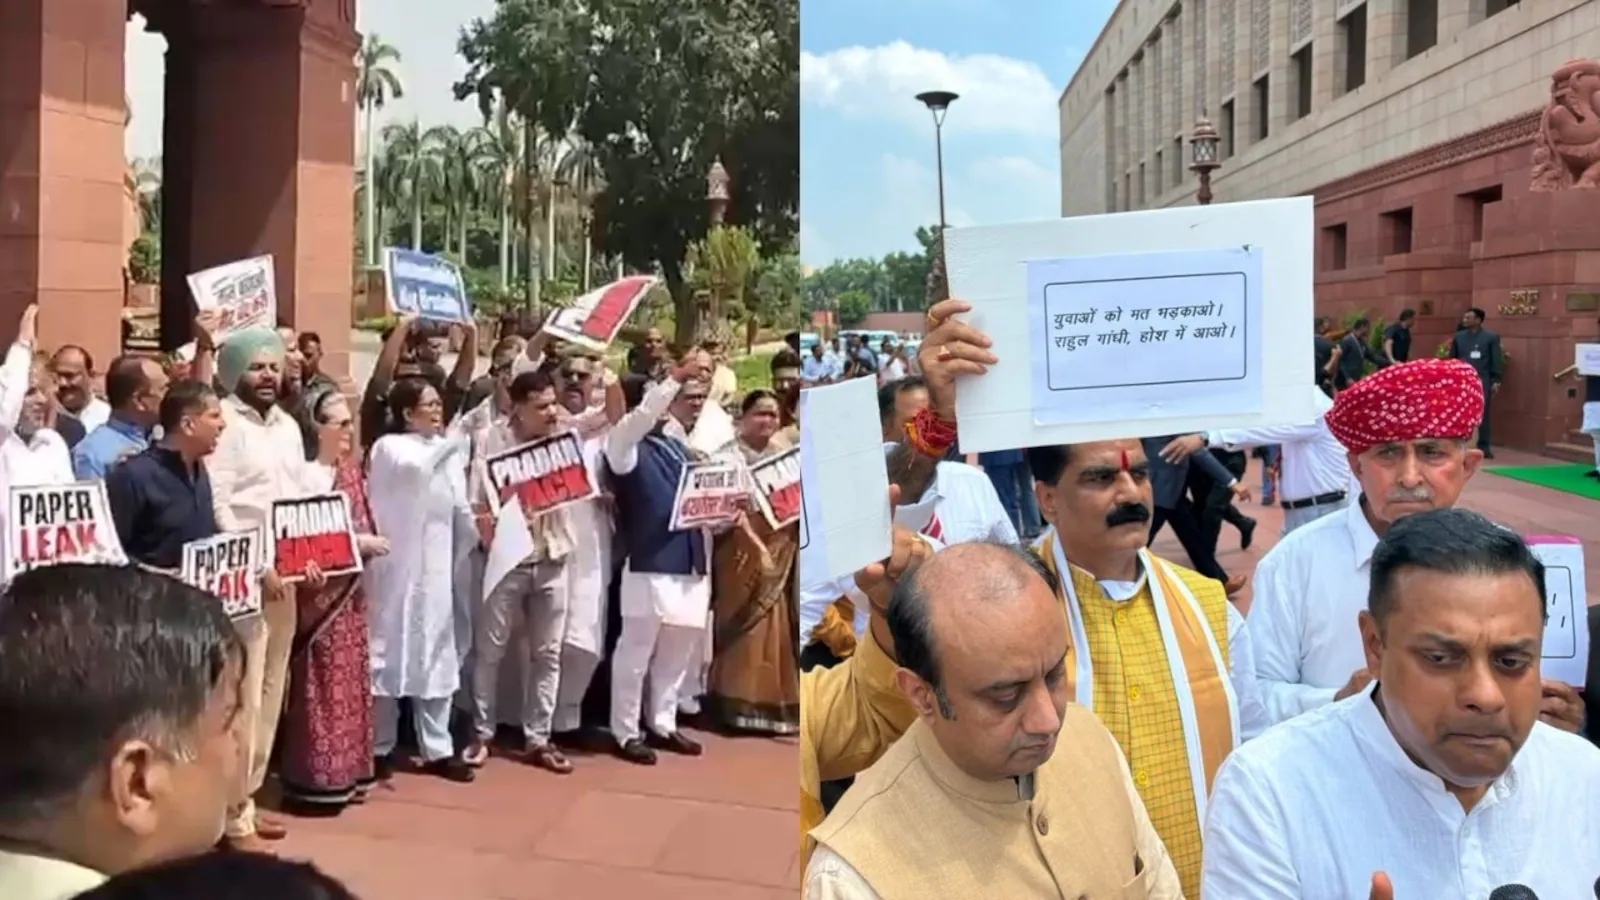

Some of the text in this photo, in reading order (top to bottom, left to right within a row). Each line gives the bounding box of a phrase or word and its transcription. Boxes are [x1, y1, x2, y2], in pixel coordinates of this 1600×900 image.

[1053, 307, 1098, 329] युवाओं
[1104, 306, 1122, 322] को
[1130, 308, 1151, 321] मत
[1054, 334, 1090, 351] राहुल
[1097, 328, 1131, 346] गांधी,
[1139, 326, 1168, 343] होश
[1175, 324, 1188, 340] में
[18, 490, 94, 526] PAPER
[275, 500, 348, 540] PRADAN
[20, 522, 97, 562] LEAK
[195, 537, 250, 580] PAPER
